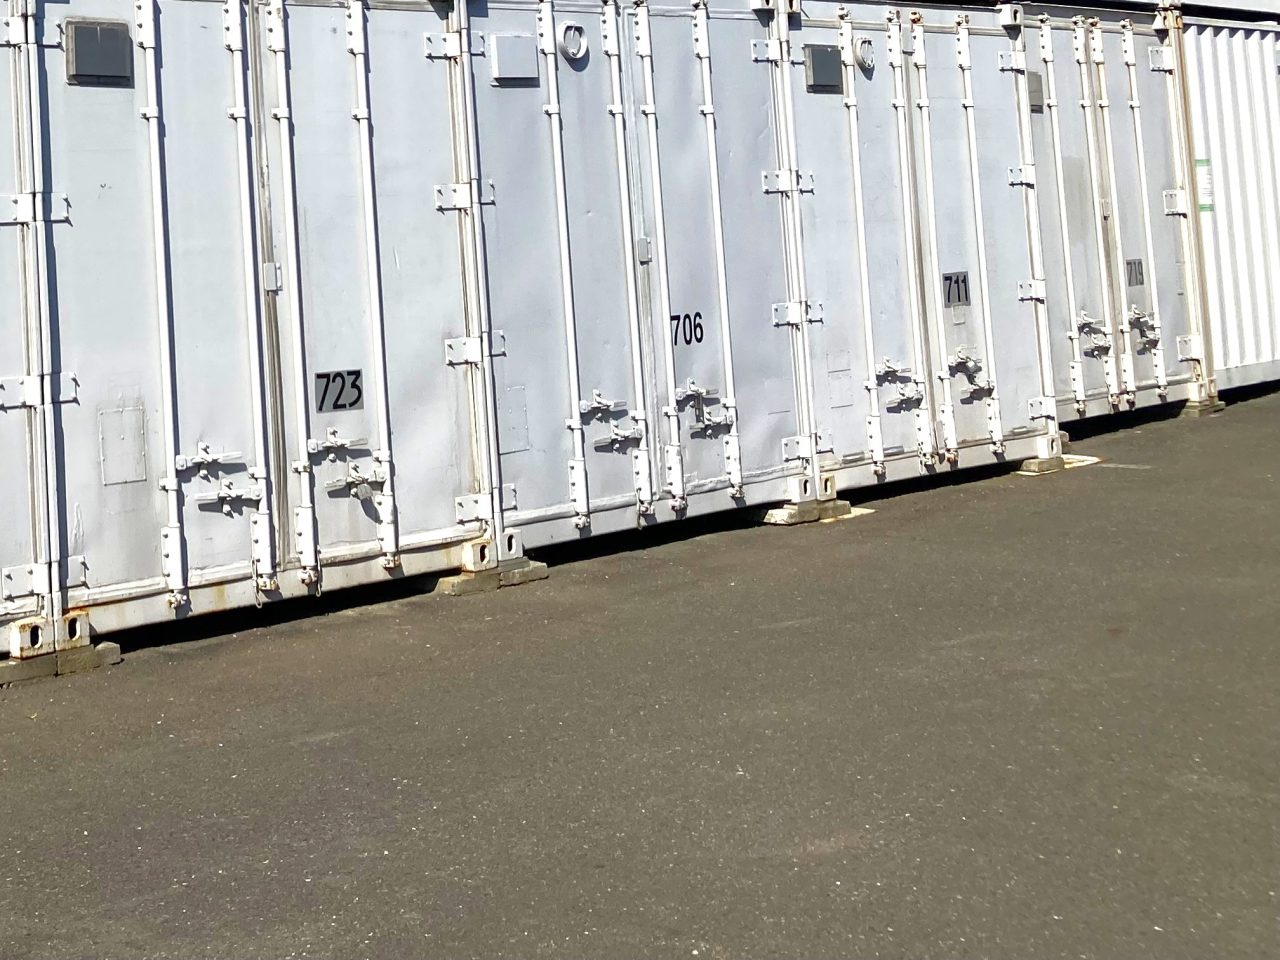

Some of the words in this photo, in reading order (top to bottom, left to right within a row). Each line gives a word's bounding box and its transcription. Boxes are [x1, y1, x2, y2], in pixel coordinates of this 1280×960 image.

[944, 275, 968, 303] 711
[671, 311, 704, 346] 706
[316, 370, 362, 411] 723
